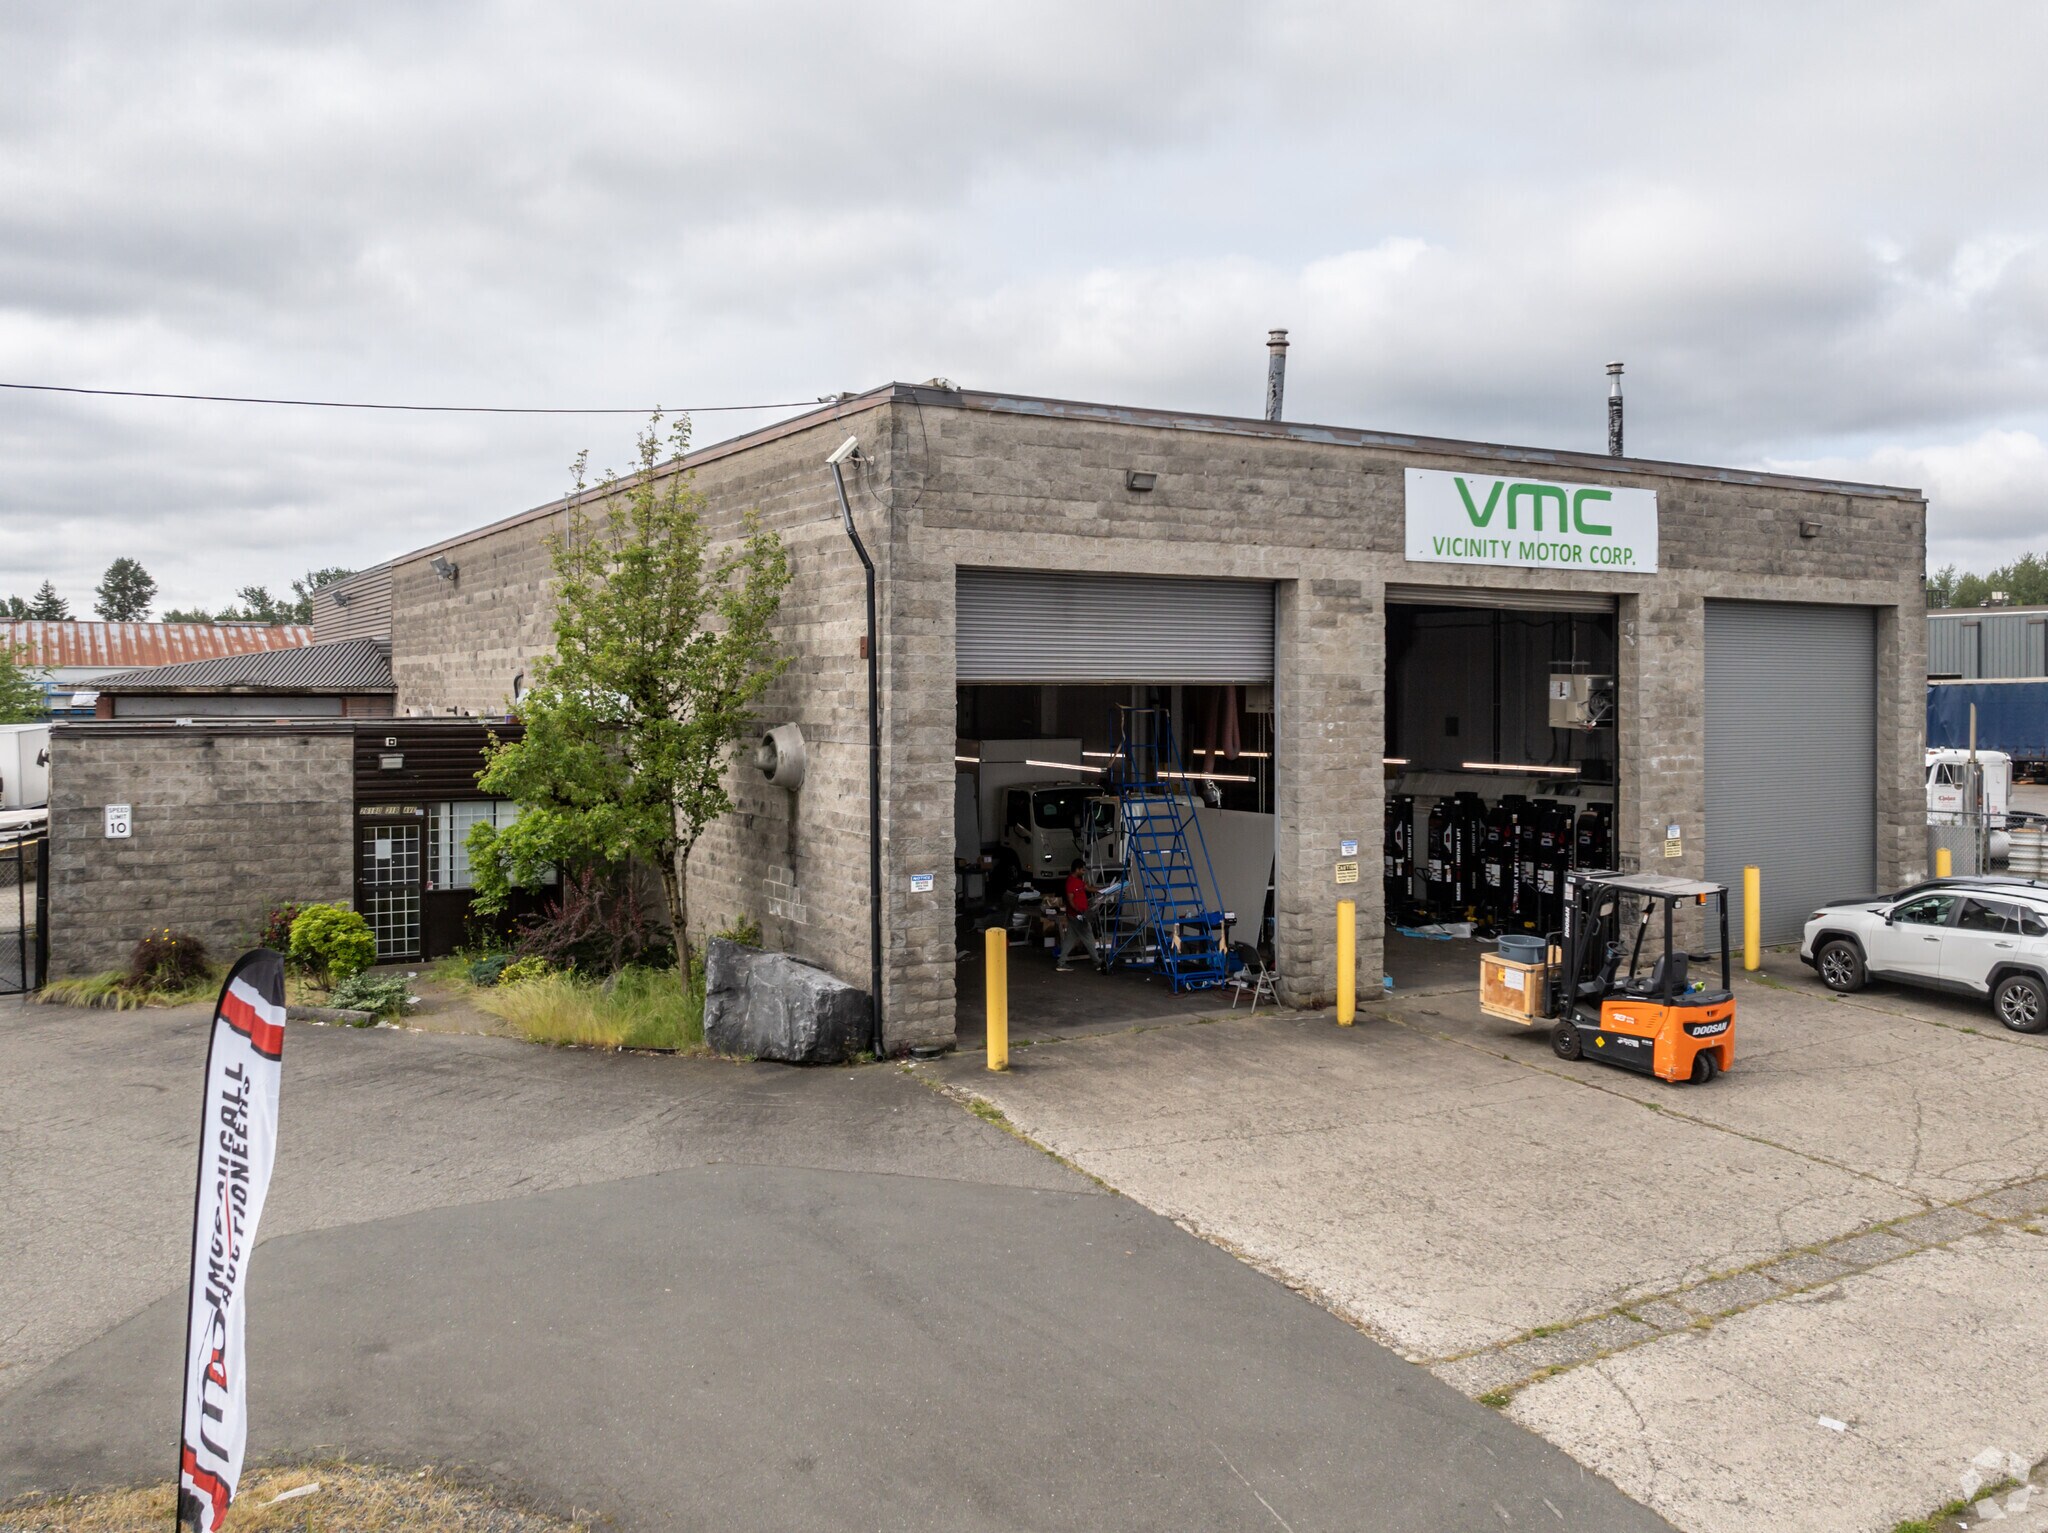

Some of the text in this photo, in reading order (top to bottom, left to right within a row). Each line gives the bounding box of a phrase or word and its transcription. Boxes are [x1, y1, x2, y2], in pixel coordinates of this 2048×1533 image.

[1453, 476, 1613, 537] VMC
[1432, 535, 1636, 566] VICINITY MOTOR CORP.
[110, 822, 127, 834] 10
[1692, 1021, 1728, 1036] DOOSAN
